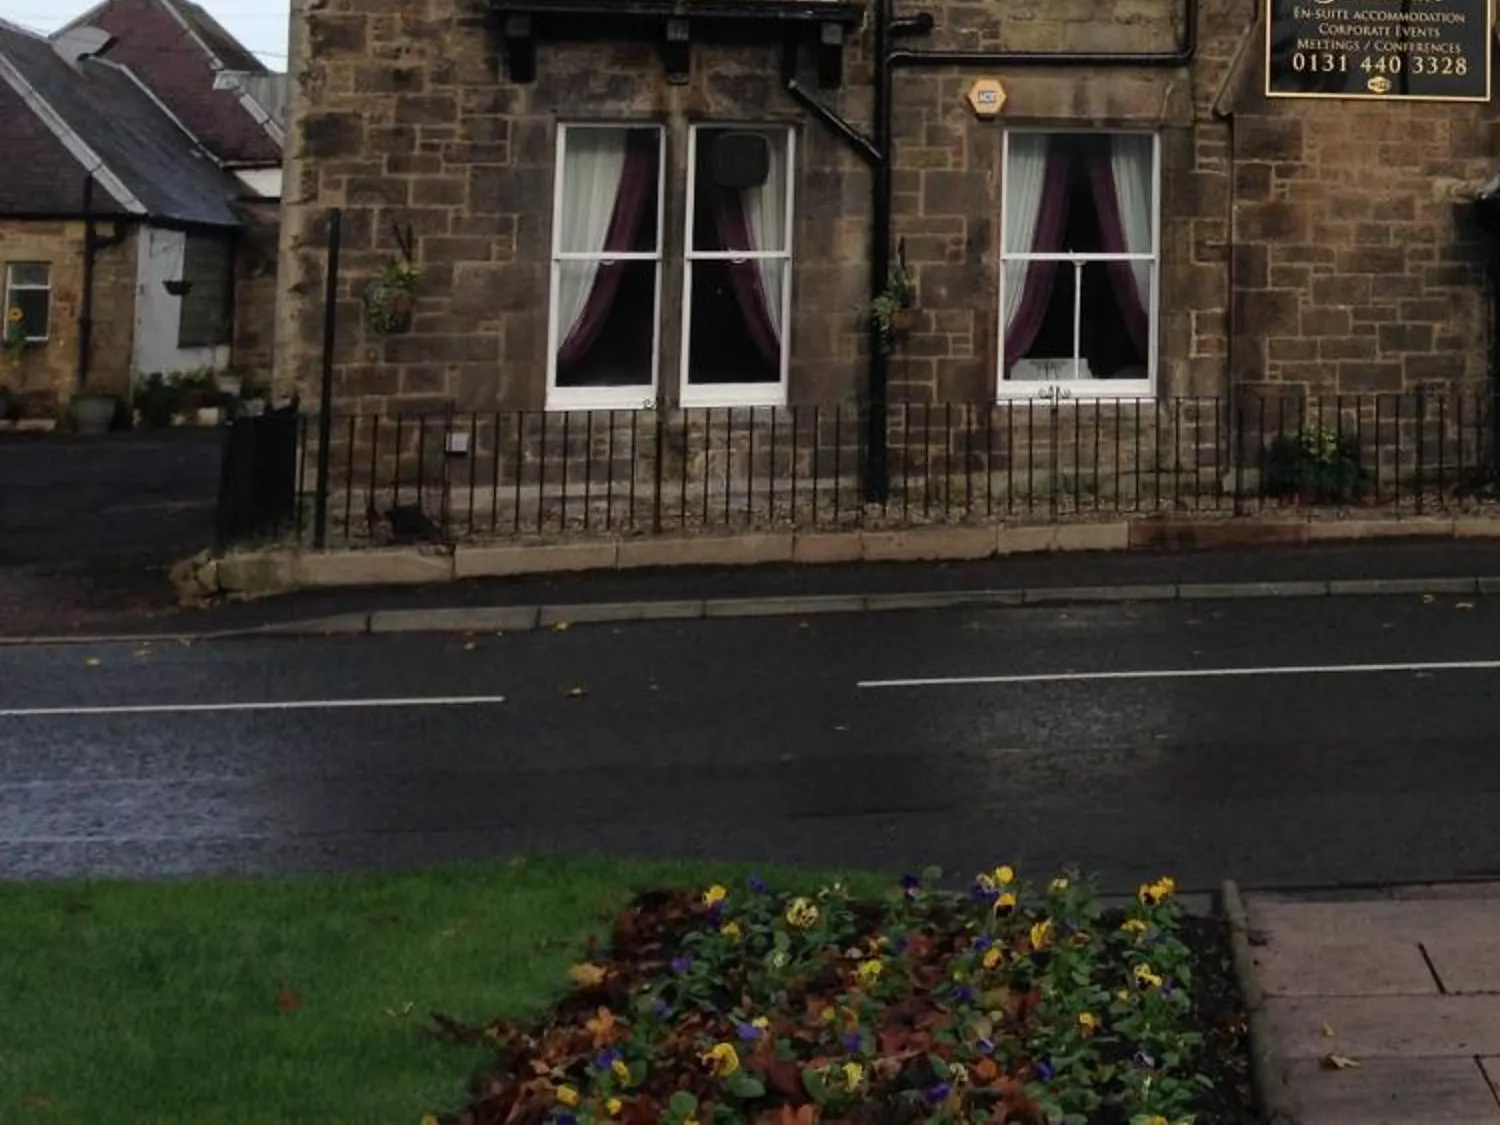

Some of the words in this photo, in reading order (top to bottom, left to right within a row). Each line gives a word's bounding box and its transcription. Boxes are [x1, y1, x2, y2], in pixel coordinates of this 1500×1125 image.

[1293, 52, 1347, 72] 0131
[1360, 55, 1401, 73] 440
[1412, 56, 1467, 75] 3328
